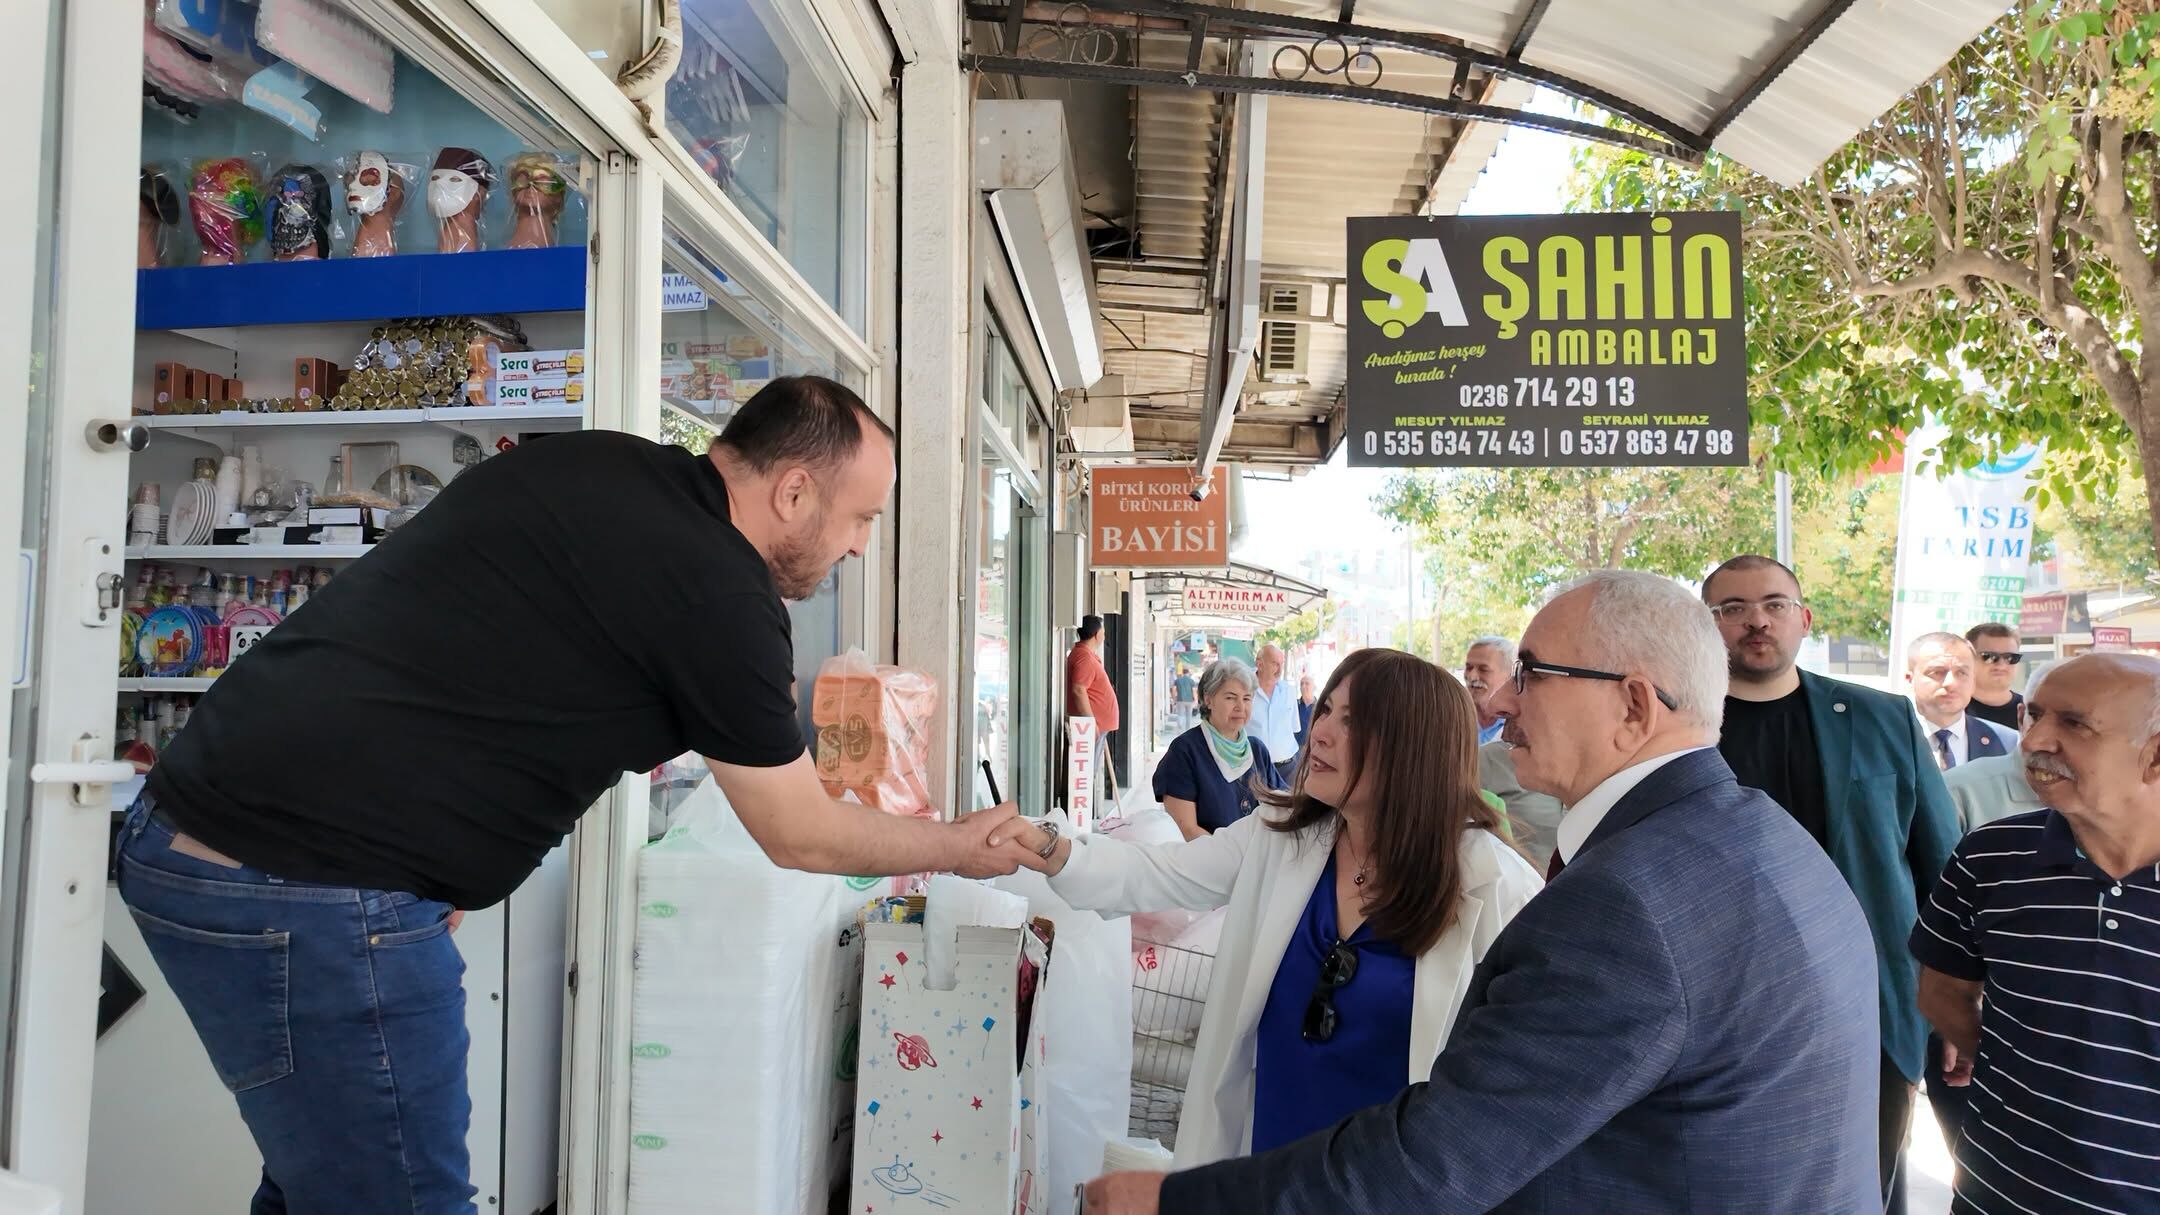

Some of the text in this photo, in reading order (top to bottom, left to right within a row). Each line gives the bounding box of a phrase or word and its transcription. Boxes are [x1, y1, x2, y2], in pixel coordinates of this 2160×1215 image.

[1482, 216, 1732, 339] ŞAHİN
[663, 292, 702, 305] INMAZ
[1364, 344, 1487, 368] Aradığınız herşey
[1530, 329, 1717, 366] AMBALAJ
[501, 358, 528, 370] Sera
[1394, 367, 1446, 384] burada
[500, 386, 527, 398] Sera
[1459, 376, 1635, 408] 0236 714 29 13
[1395, 416, 1506, 427] MESUT YILMAZ
[1582, 413, 1710, 426] SEYRANİ YILMAZ
[1364, 429, 1535, 456] 0 535 634 74 43
[1559, 429, 1734, 455] 0 537 863 47 98
[1100, 481, 1218, 496] BİTKİ KORUA
[1119, 497, 1200, 512] ÜRÜNLERİ
[1954, 504, 2030, 530] TSB
[1100, 520, 1218, 552] BAYİSİ
[1188, 589, 1285, 603] ALTINIRMAK
[1191, 602, 1267, 612] KUYUMCULUK
[1073, 722, 1091, 828] VETERİ
